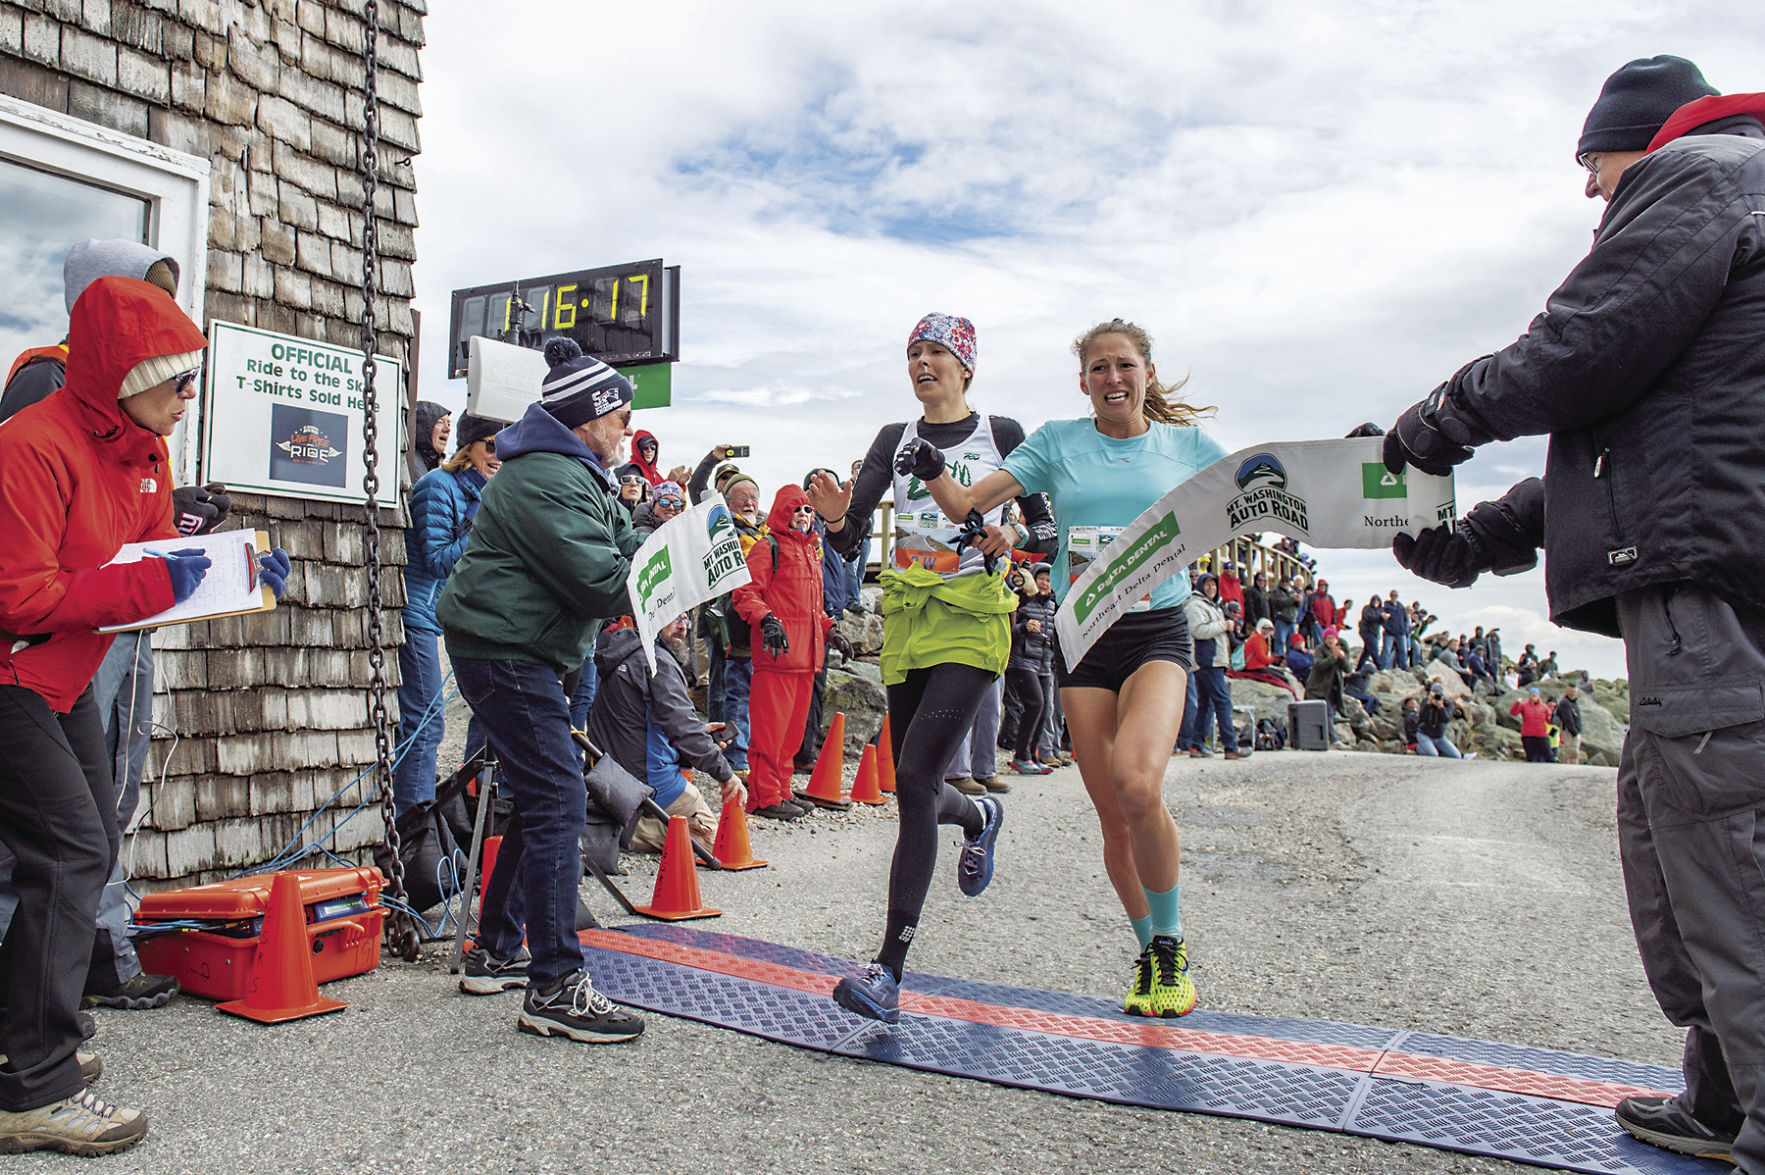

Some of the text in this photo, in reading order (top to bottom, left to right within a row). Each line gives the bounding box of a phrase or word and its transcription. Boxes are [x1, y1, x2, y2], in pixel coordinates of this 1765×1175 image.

[271, 343, 353, 375] OFFICIAL
[247, 359, 364, 392] Ride to the Sk
[236, 376, 380, 412] T-Shirts Sold Hee
[290, 444, 329, 463] RIDE
[1226, 489, 1307, 516] MT. WASHINGTON
[1230, 500, 1309, 531] AUTO ROAD
[708, 555, 733, 587] AUTO
[1097, 530, 1168, 592] DELTA DENTAL
[1124, 573, 1151, 595] Delta
[1153, 543, 1186, 573] Dental
